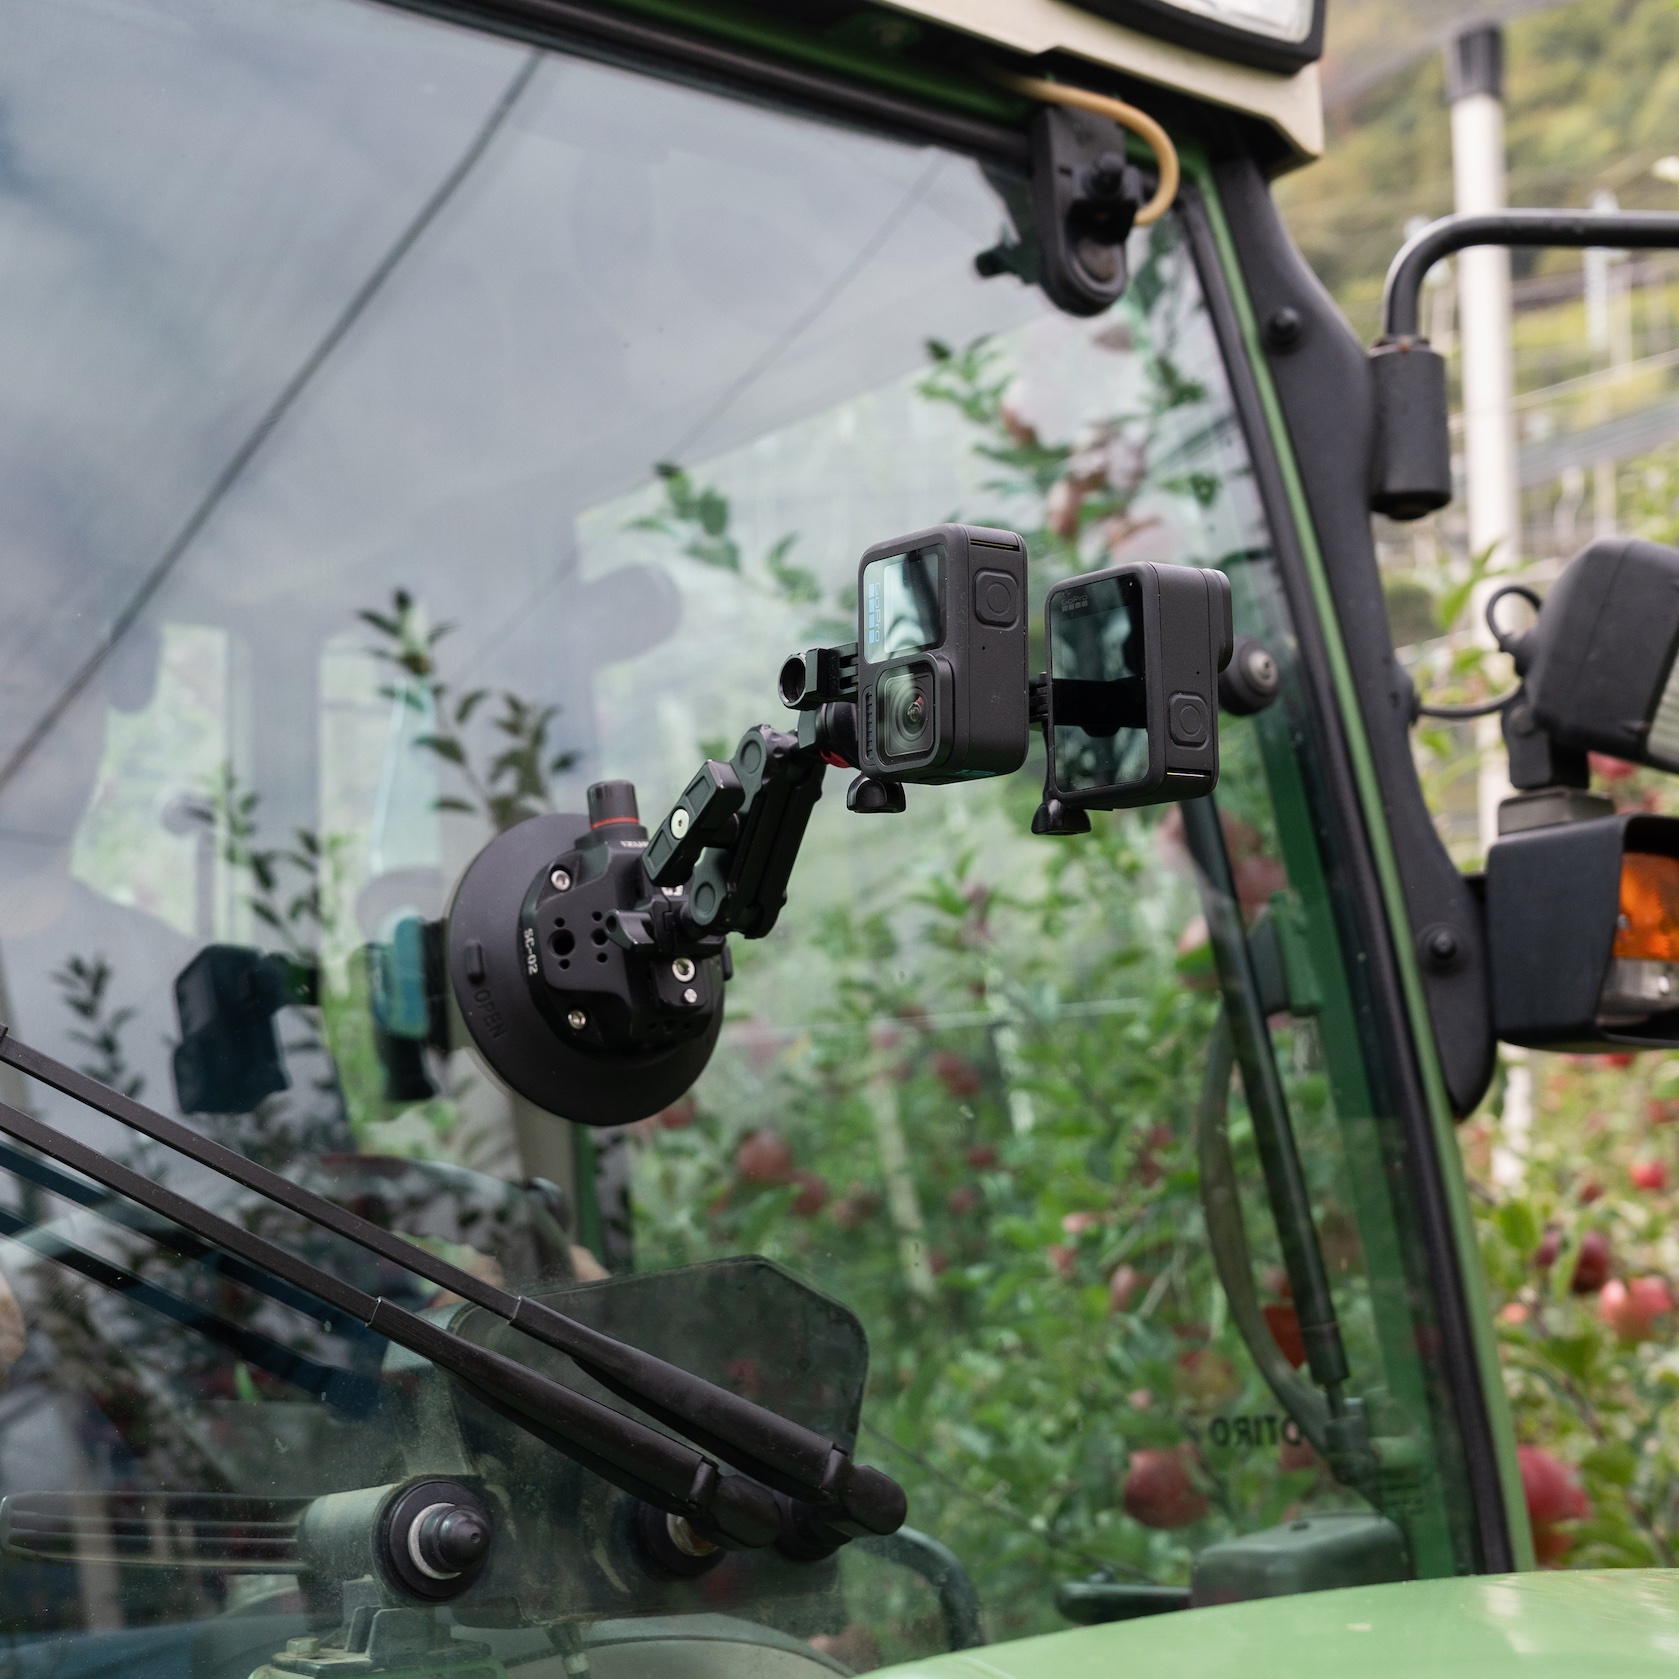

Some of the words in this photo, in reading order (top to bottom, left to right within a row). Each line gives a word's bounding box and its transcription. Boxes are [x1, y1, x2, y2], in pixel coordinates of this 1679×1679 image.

[1061, 595, 1088, 606] GoPro
[523, 928, 538, 976] SC-02
[474, 990, 508, 1039] OPEN
